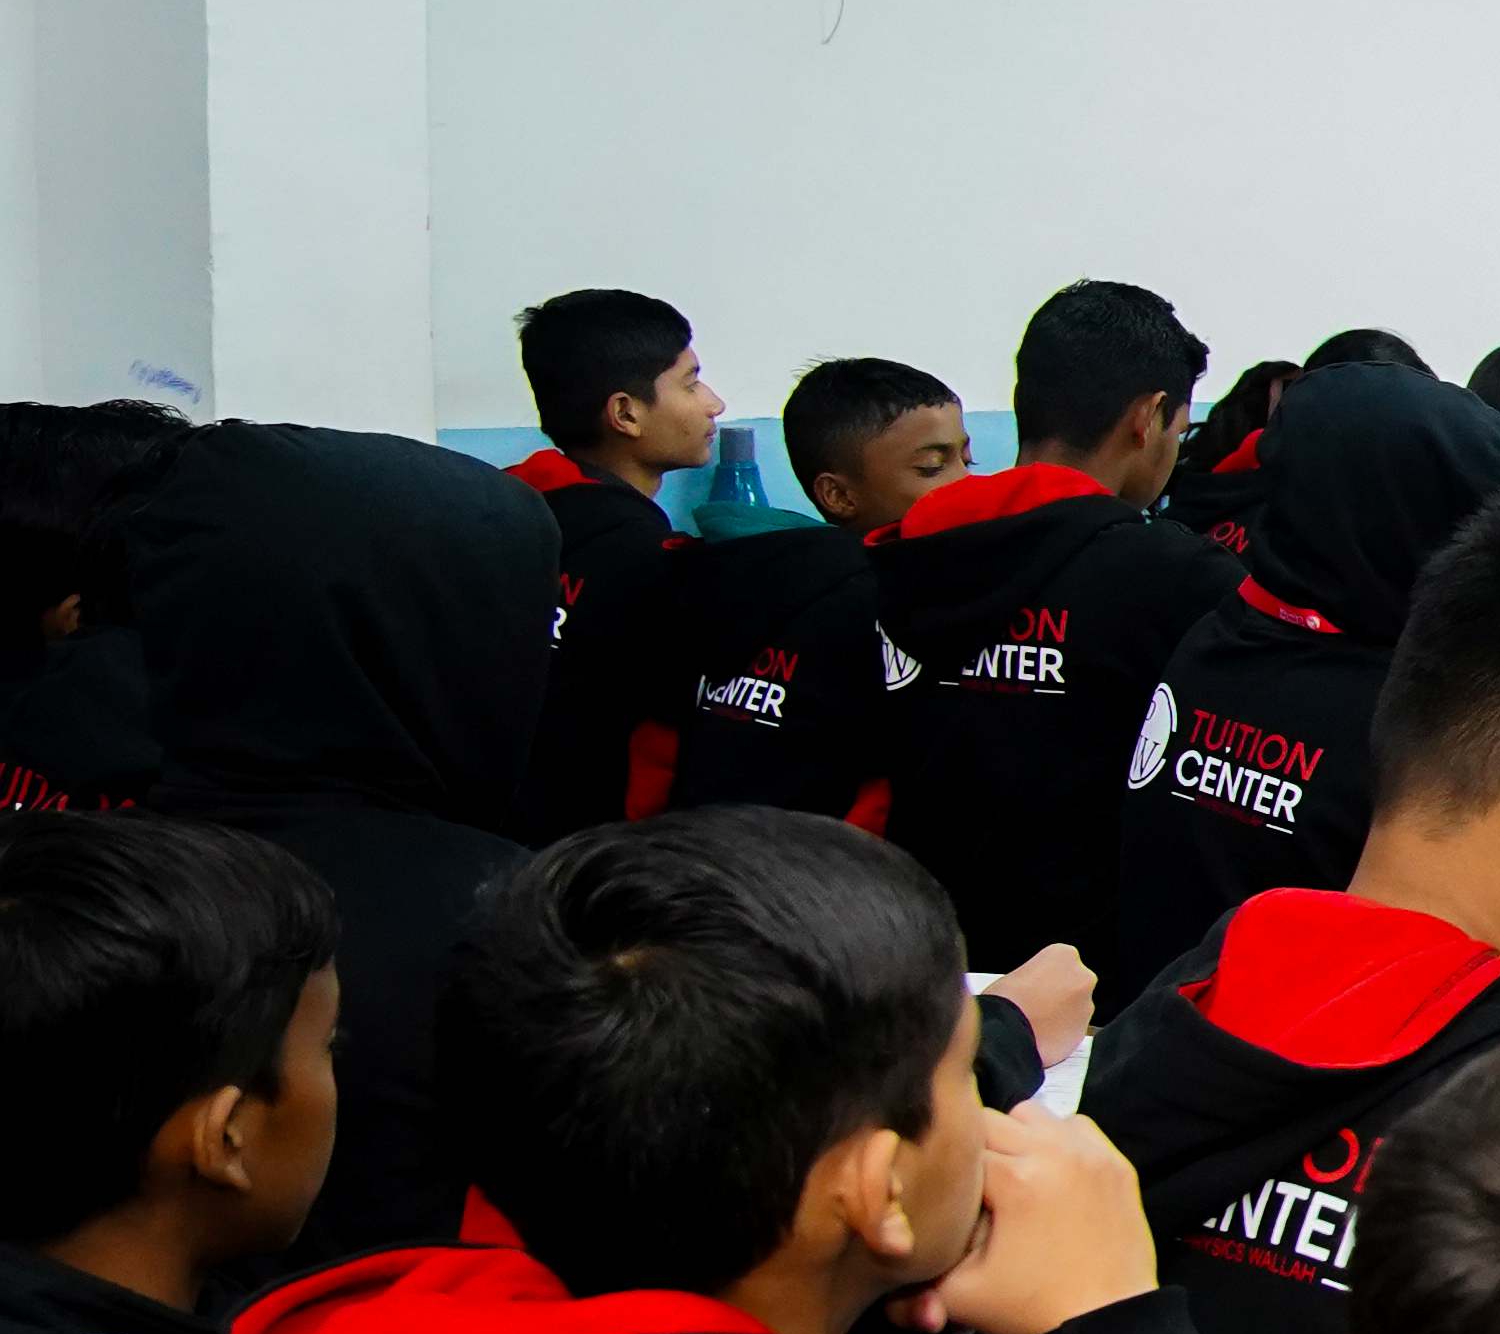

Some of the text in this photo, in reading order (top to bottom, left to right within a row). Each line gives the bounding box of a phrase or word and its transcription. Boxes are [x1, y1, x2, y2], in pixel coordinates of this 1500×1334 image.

[962, 644, 1066, 684] NTER
[1189, 708, 1325, 782] TUITION
[1175, 749, 1303, 823] CENTER
[1203, 1178, 1359, 1269] NTE
[1248, 1245, 1317, 1284] WALLAH
